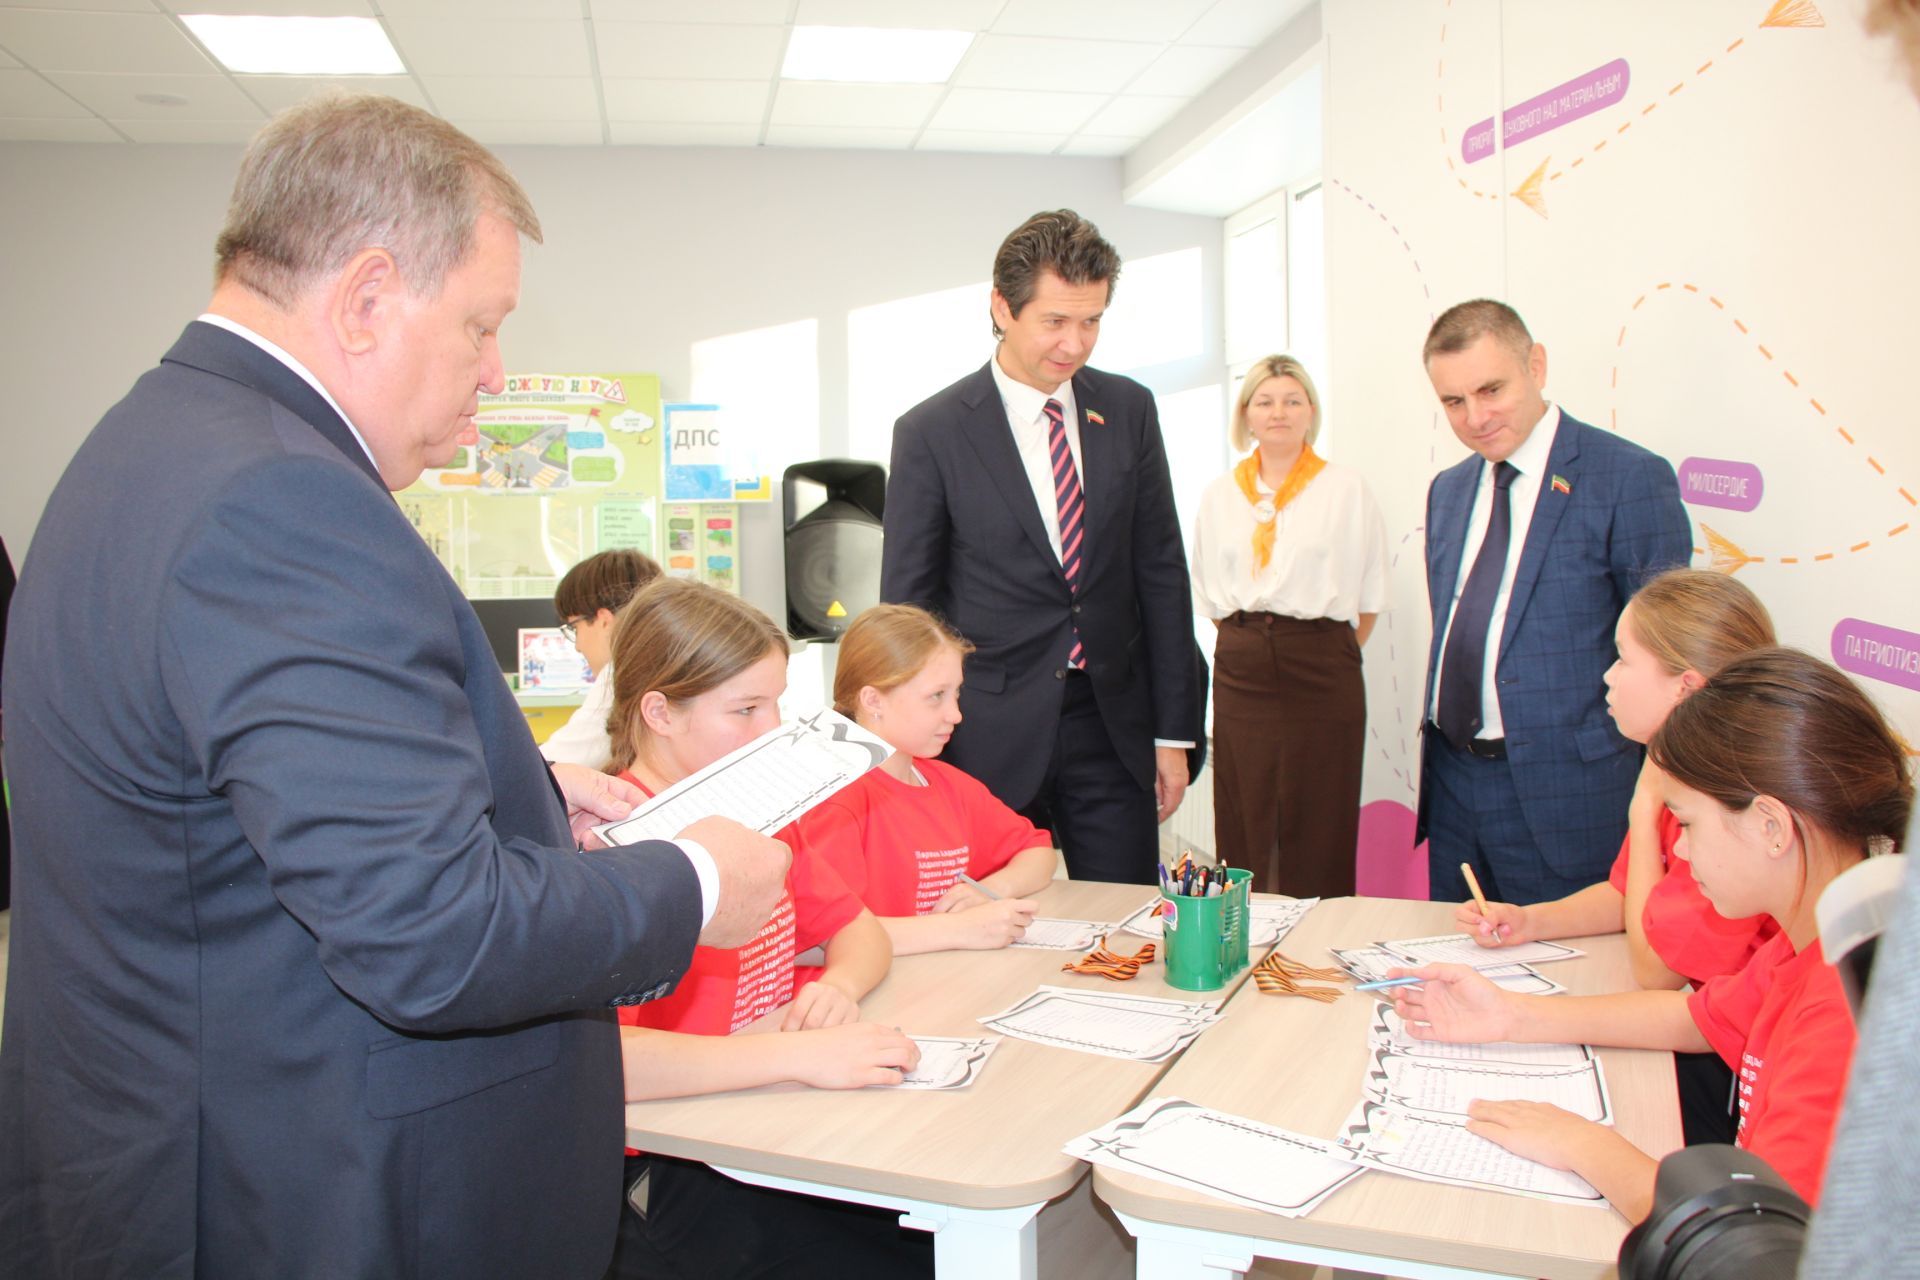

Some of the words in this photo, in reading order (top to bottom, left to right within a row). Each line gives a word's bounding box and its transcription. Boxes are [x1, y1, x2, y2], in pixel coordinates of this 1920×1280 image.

[1543, 100, 1558, 119] НАД
[1560, 72, 1621, 113] МАТЕРИАЛЬНЫМ
[674, 429, 720, 450] ДПС
[1686, 471, 1750, 499] МИЛОСЕРДИЕ
[1844, 634, 1920, 674] ПАТРИОТИЗ
